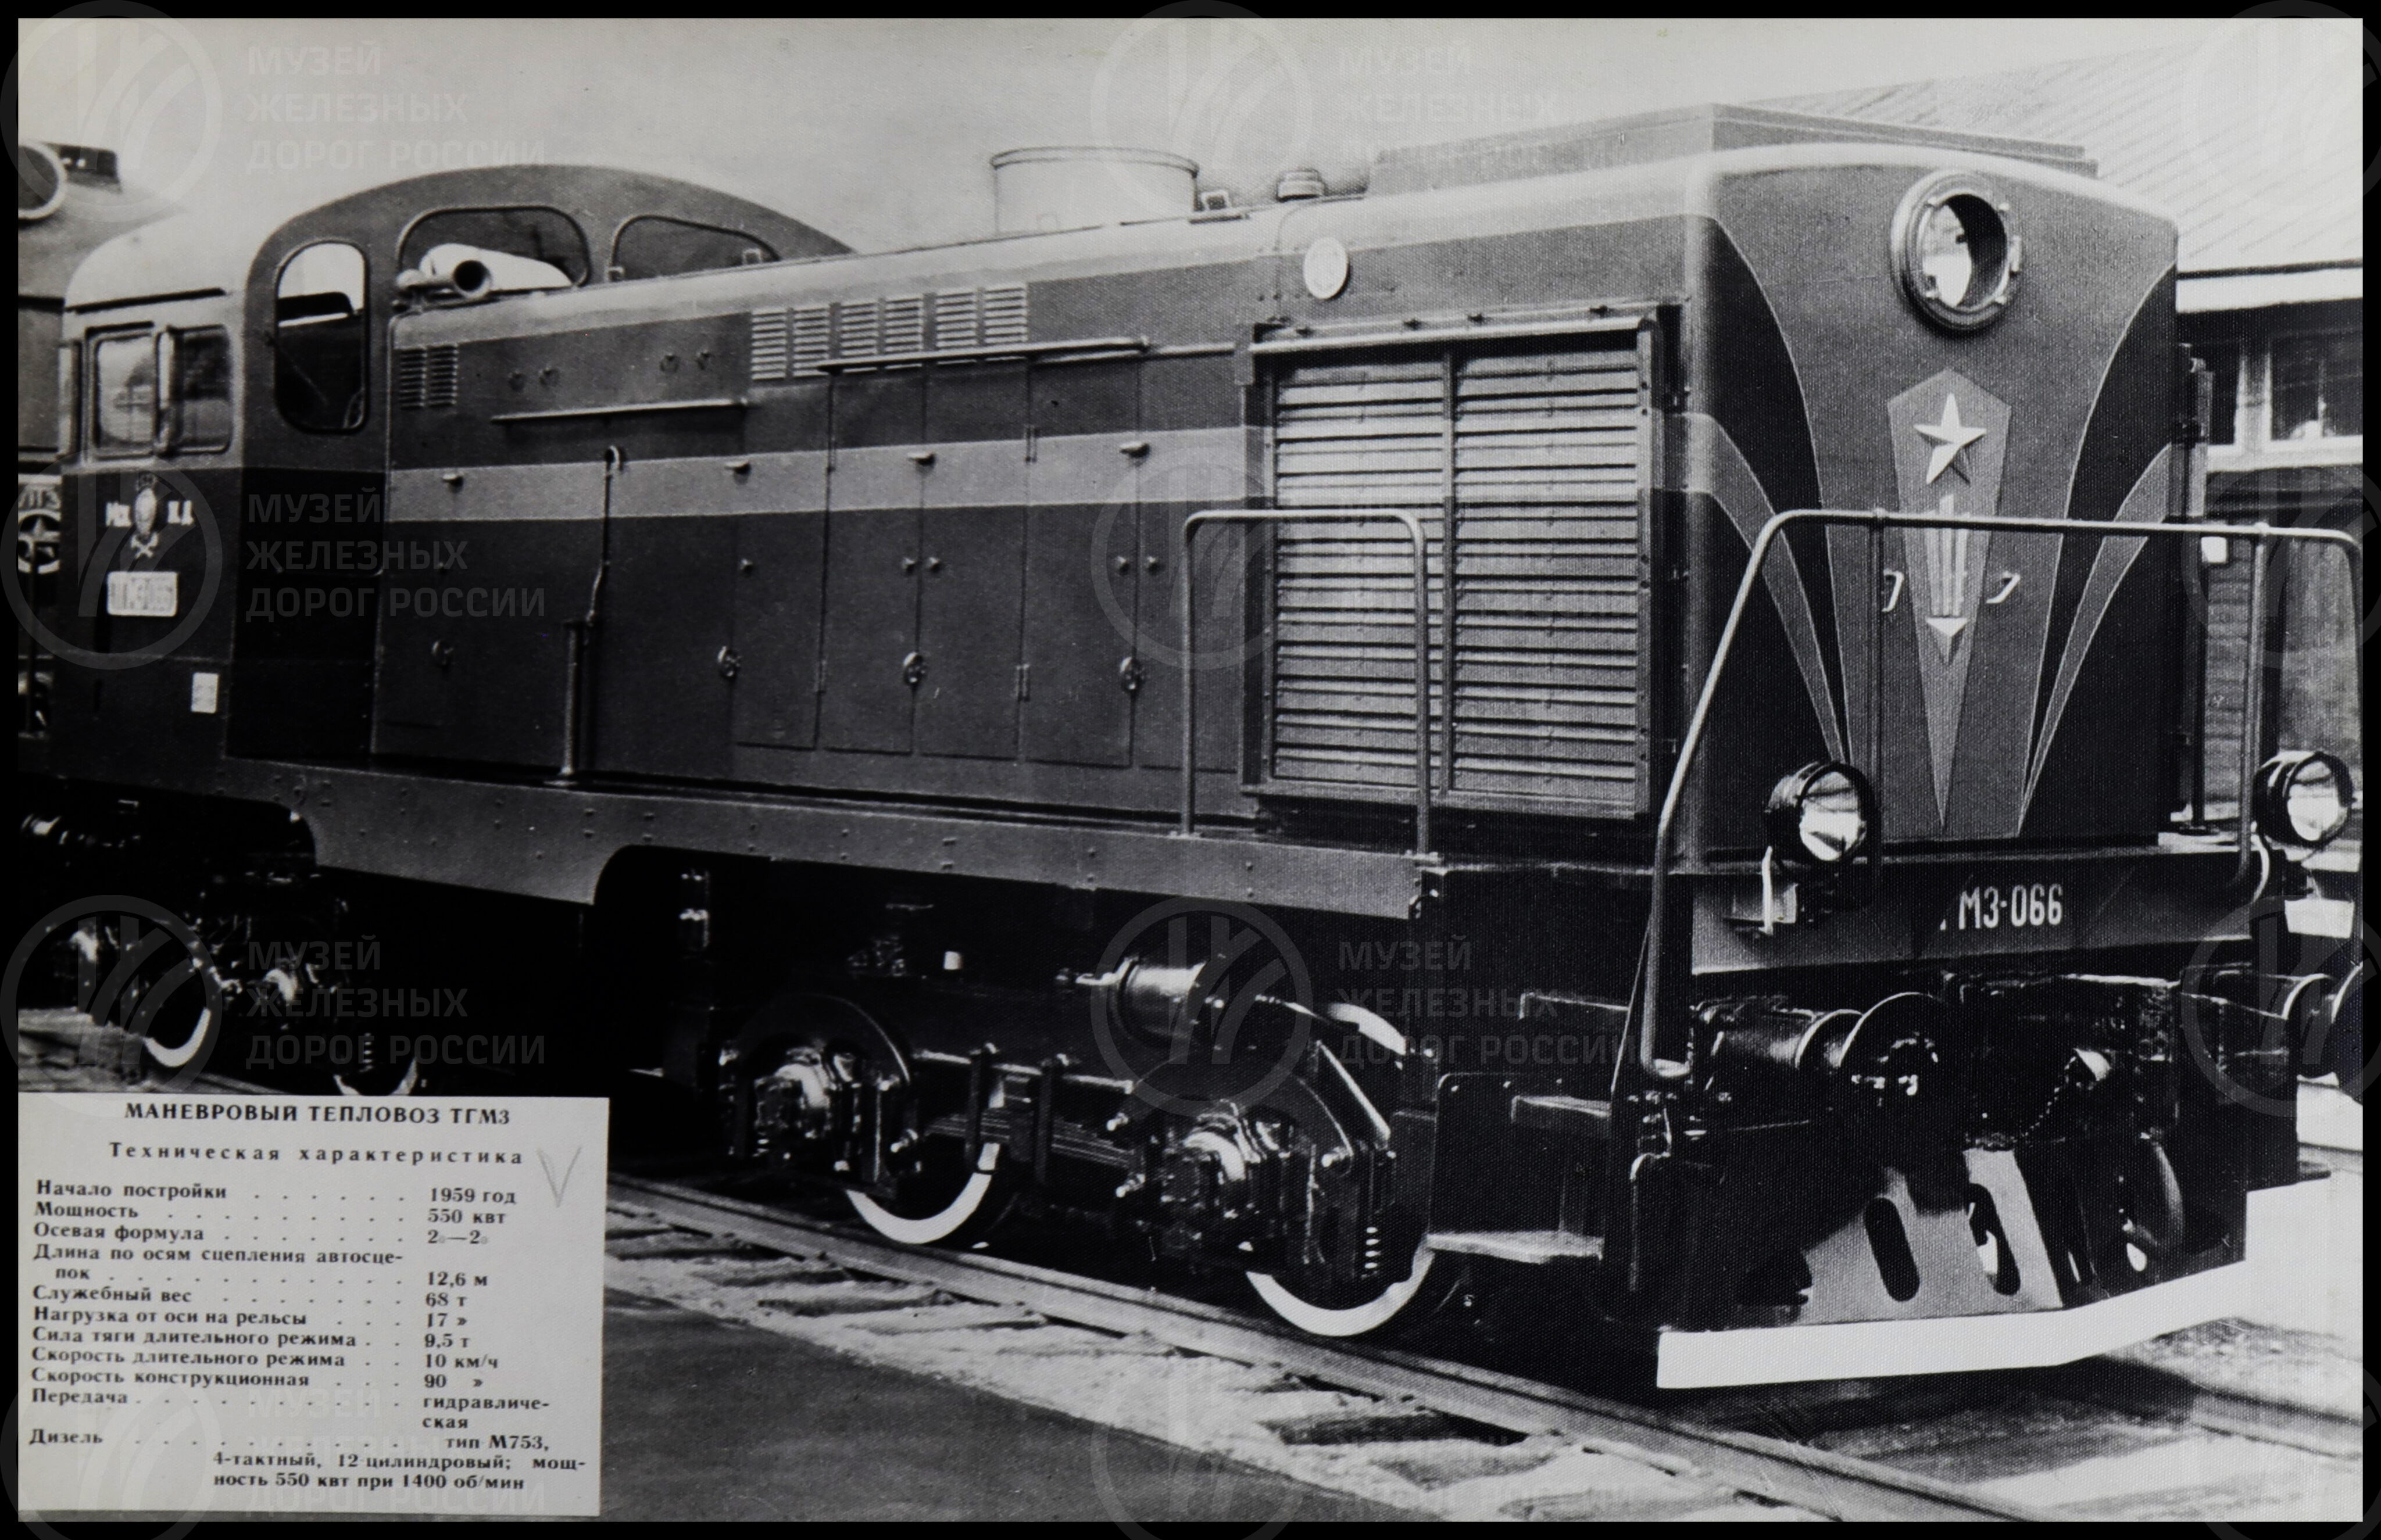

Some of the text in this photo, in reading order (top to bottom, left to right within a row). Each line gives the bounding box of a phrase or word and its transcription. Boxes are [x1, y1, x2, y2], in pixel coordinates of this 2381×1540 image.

[1940, 883, 2063, 930] М3-066
[124, 1102, 298, 1122] МАНЕВРОВЫЙ
[308, 1105, 440, 1124] ТЕПЛОВОЗ
[109, 1141, 522, 1166] Техническая характеристика
[37, 1179, 517, 1205] Начало постройки 1959 год
[35, 1201, 506, 1224] Мощность 550 квт
[33, 1222, 105, 1238] Осевая
[114, 1224, 204, 1244] формула
[33, 1243, 403, 1265] Длина по осям сцепления автосце-
[55, 1268, 488, 1288] пок 12,6 м
[32, 1284, 467, 1308] Служебный вес 68 т
[34, 1305, 128, 1326] Нагрузка
[136, 1312, 157, 1323] от
[164, 1312, 198, 1323] оси
[205, 1313, 228, 1324] на
[236, 1312, 306, 1327] рельсы
[427, 1312, 448, 1328] 17
[32, 1326, 83, 1343] Сила
[93, 1331, 135, 1342] тяги
[144, 1332, 269, 1345] длительного
[277, 1334, 356, 1348] режима
[460, 1337, 469, 1348] т
[31, 1346, 498, 1369] Скорость длительного режима 10 км/ч
[31, 1367, 124, 1386] Скорость
[134, 1373, 309, 1389] конструкционная
[424, 1374, 447, 1388] 90
[32, 1388, 550, 1412] Передача гидравличе-
[421, 1417, 469, 1429] ская
[28, 1428, 549, 1452] Дизель тип М753,
[214, 1451, 321, 1469] 4-тактный,
[532, 1458, 586, 1471] мощ-
[214, 1472, 524, 1491] ность 550 квт при 1400 об/мин
